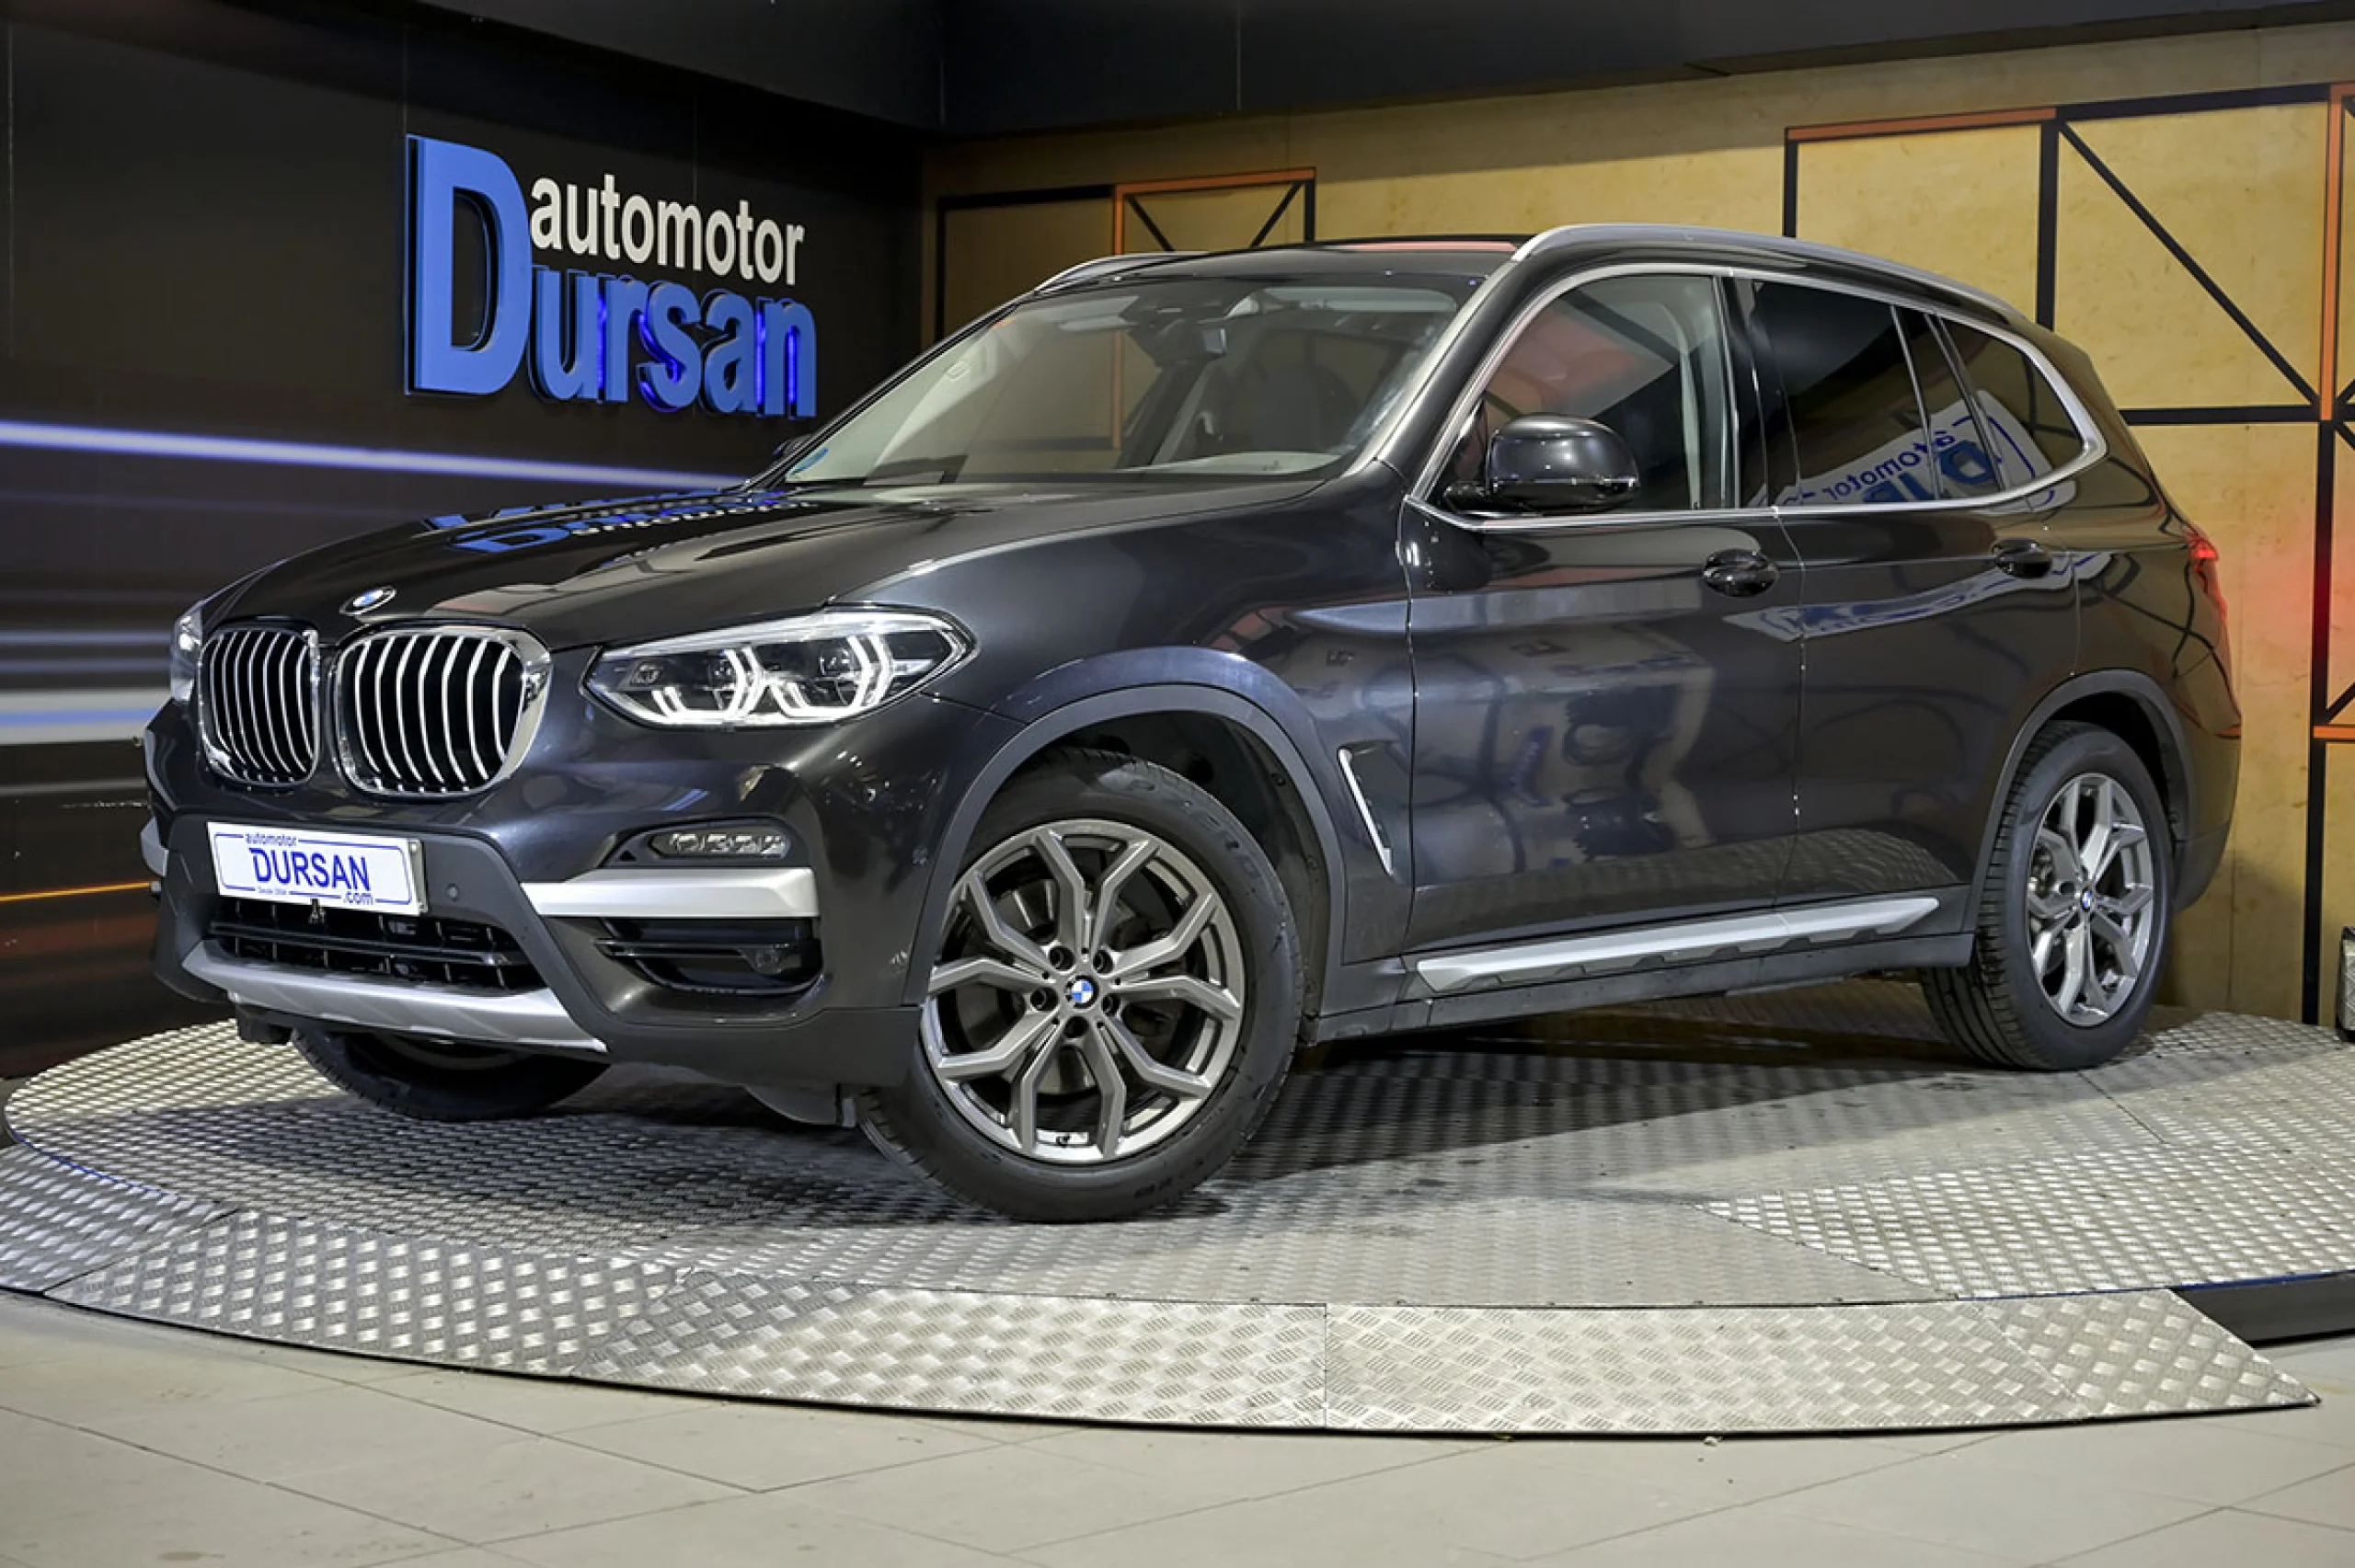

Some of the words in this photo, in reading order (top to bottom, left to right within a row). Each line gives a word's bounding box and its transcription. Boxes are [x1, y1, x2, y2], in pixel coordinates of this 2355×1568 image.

[530, 174, 805, 285] automotor
[406, 134, 817, 418] Dursan
[245, 832, 297, 846] automotor
[248, 847, 371, 891] DURSAN
[343, 891, 373, 906] .com
